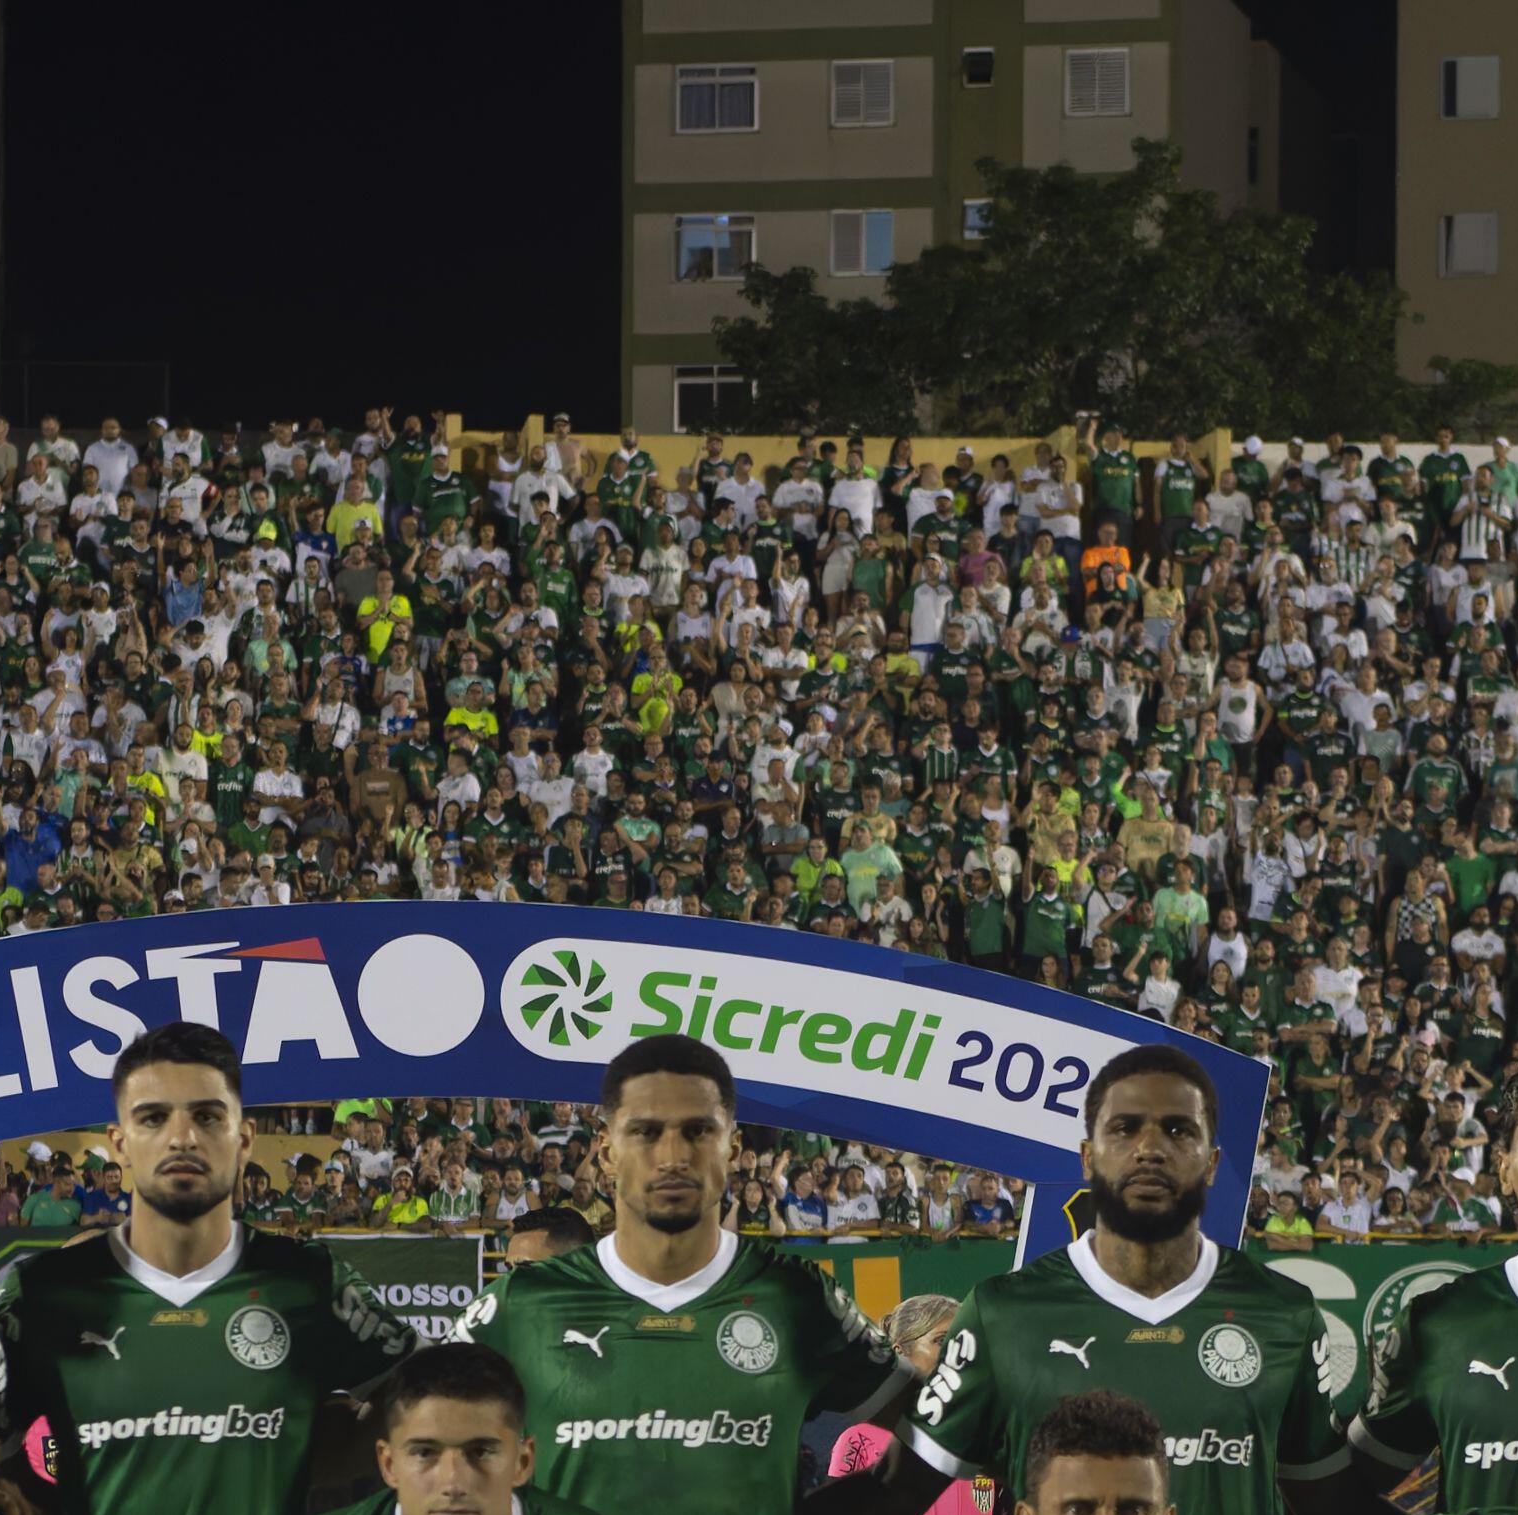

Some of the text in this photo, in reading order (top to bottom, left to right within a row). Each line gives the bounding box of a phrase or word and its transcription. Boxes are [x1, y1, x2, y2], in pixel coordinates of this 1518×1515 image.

[631, 971, 942, 1082] Sicredi
[1204, 1346, 1261, 1383] PALMEIRAS
[78, 1404, 285, 1445] sportingbet
[556, 1409, 772, 1450] sportingbet
